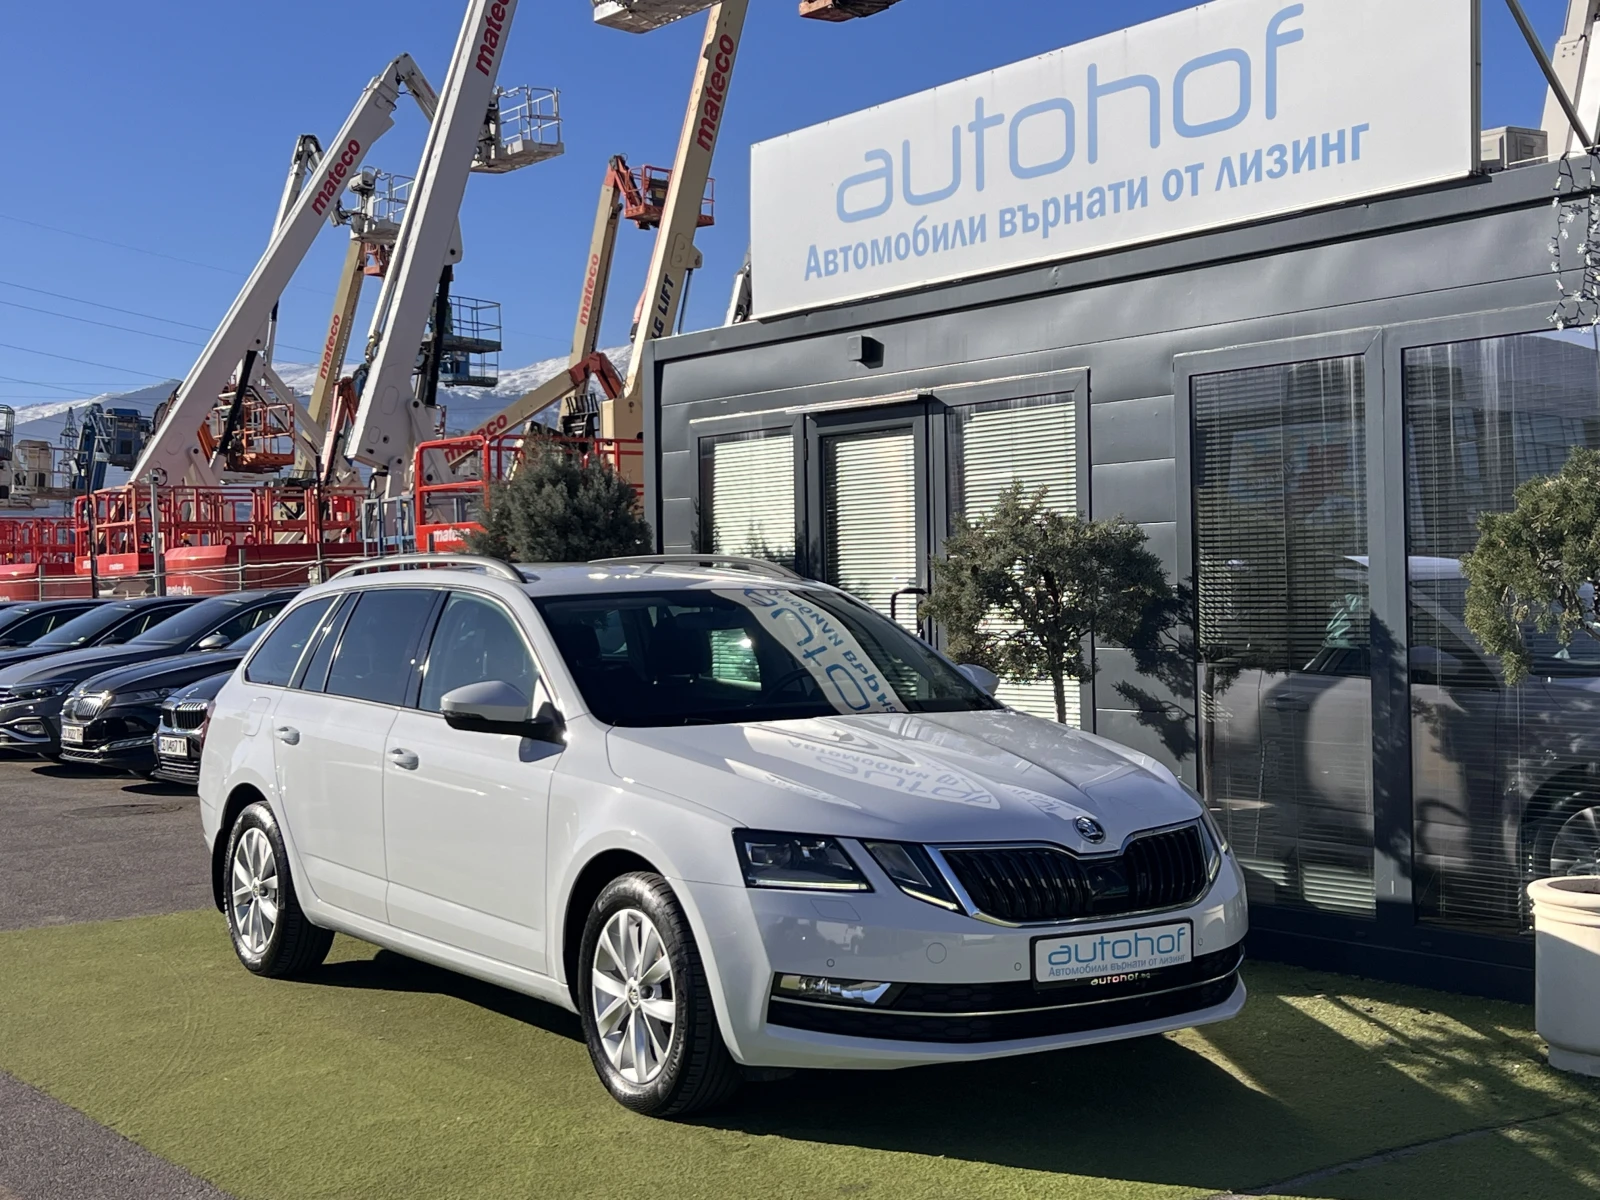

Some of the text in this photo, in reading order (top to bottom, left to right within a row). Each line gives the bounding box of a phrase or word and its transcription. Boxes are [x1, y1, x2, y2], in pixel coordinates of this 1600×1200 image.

[476, 0, 510, 76] mate
[697, 33, 734, 152] mateco
[835, 3, 1305, 224] autohof
[311, 139, 360, 216] mateco
[804, 122, 1370, 281] Автомобили върнати от лизинг
[580, 253, 599, 326] mateco
[658, 273, 674, 316] LIFT
[320, 314, 340, 380] mateco
[1048, 927, 1186, 966] autohof
[1048, 954, 1186, 977] Автомобили върнати от лизинг
